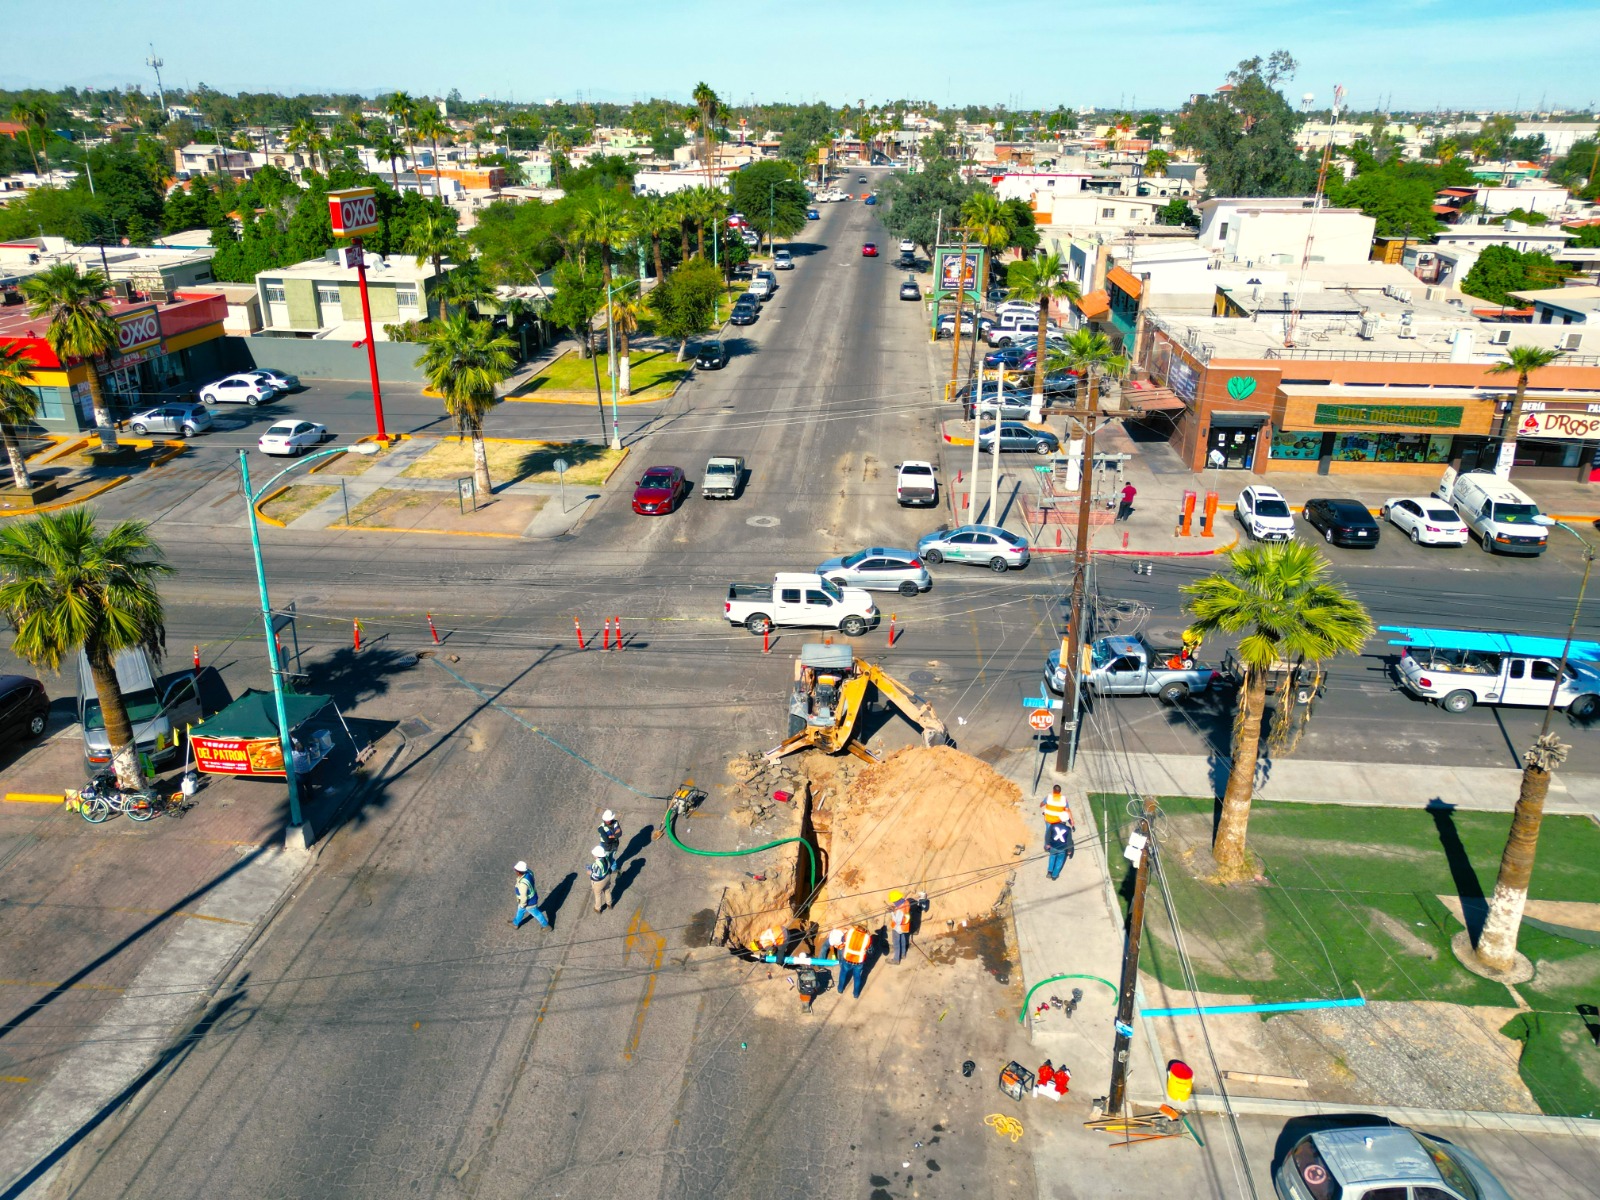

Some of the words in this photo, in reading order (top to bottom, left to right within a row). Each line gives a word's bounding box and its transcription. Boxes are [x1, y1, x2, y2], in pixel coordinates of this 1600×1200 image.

[342, 198, 376, 228] OXXO
[120, 317, 157, 347] OXXO
[1501, 402, 1546, 411] PADERÍA
[1337, 408, 1366, 422] VIVE
[1031, 715, 1053, 724] ALTO
[197, 747, 212, 759] DEL
[213, 749, 247, 761] PATRON
